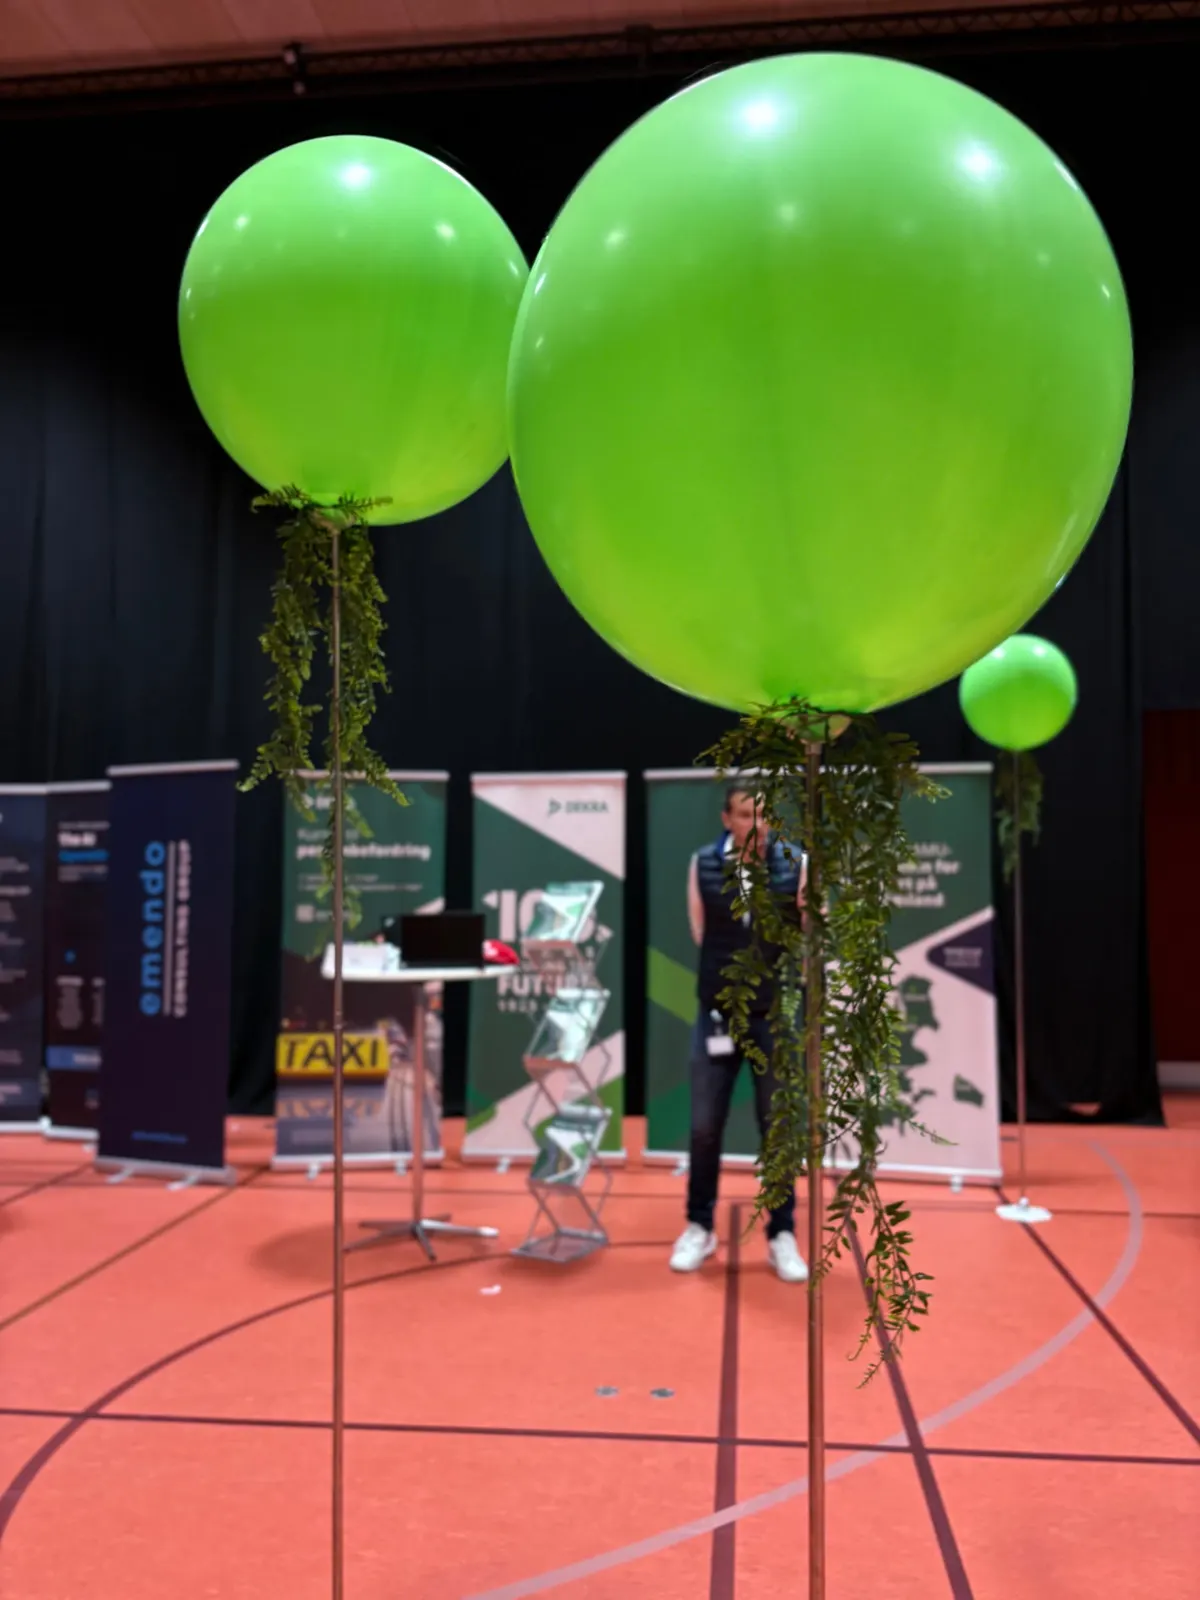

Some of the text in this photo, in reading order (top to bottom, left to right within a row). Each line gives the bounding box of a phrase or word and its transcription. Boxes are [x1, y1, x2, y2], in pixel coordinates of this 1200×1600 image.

[139, 840, 166, 1016] emendo
[174, 839, 191, 1018] CONSULTING GROUP
[284, 1037, 379, 1069] TAXI
